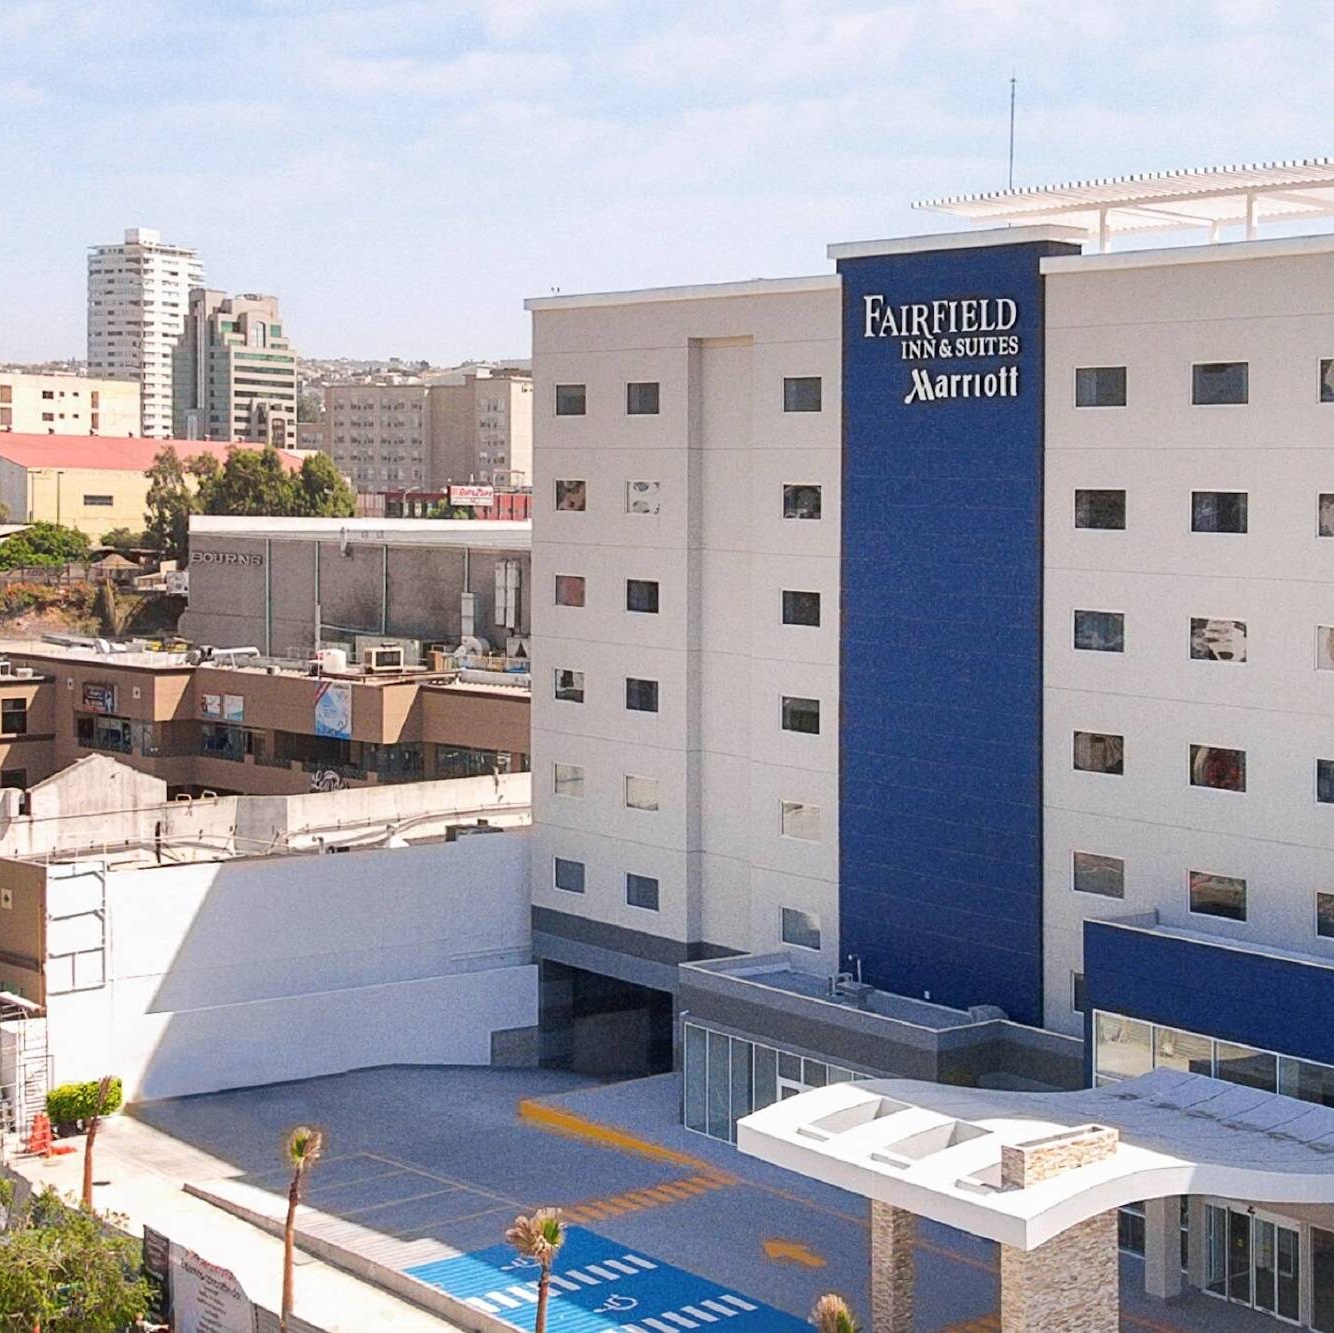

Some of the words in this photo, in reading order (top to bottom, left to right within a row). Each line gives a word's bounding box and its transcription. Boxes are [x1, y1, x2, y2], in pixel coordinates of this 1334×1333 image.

[863, 295, 1018, 339] FAIRFIELD
[901, 338, 935, 360] INN
[938, 340, 953, 358] &
[955, 336, 1019, 357] SUITES
[904, 366, 1019, 405] Marriott
[190, 551, 263, 567] BOURNS
